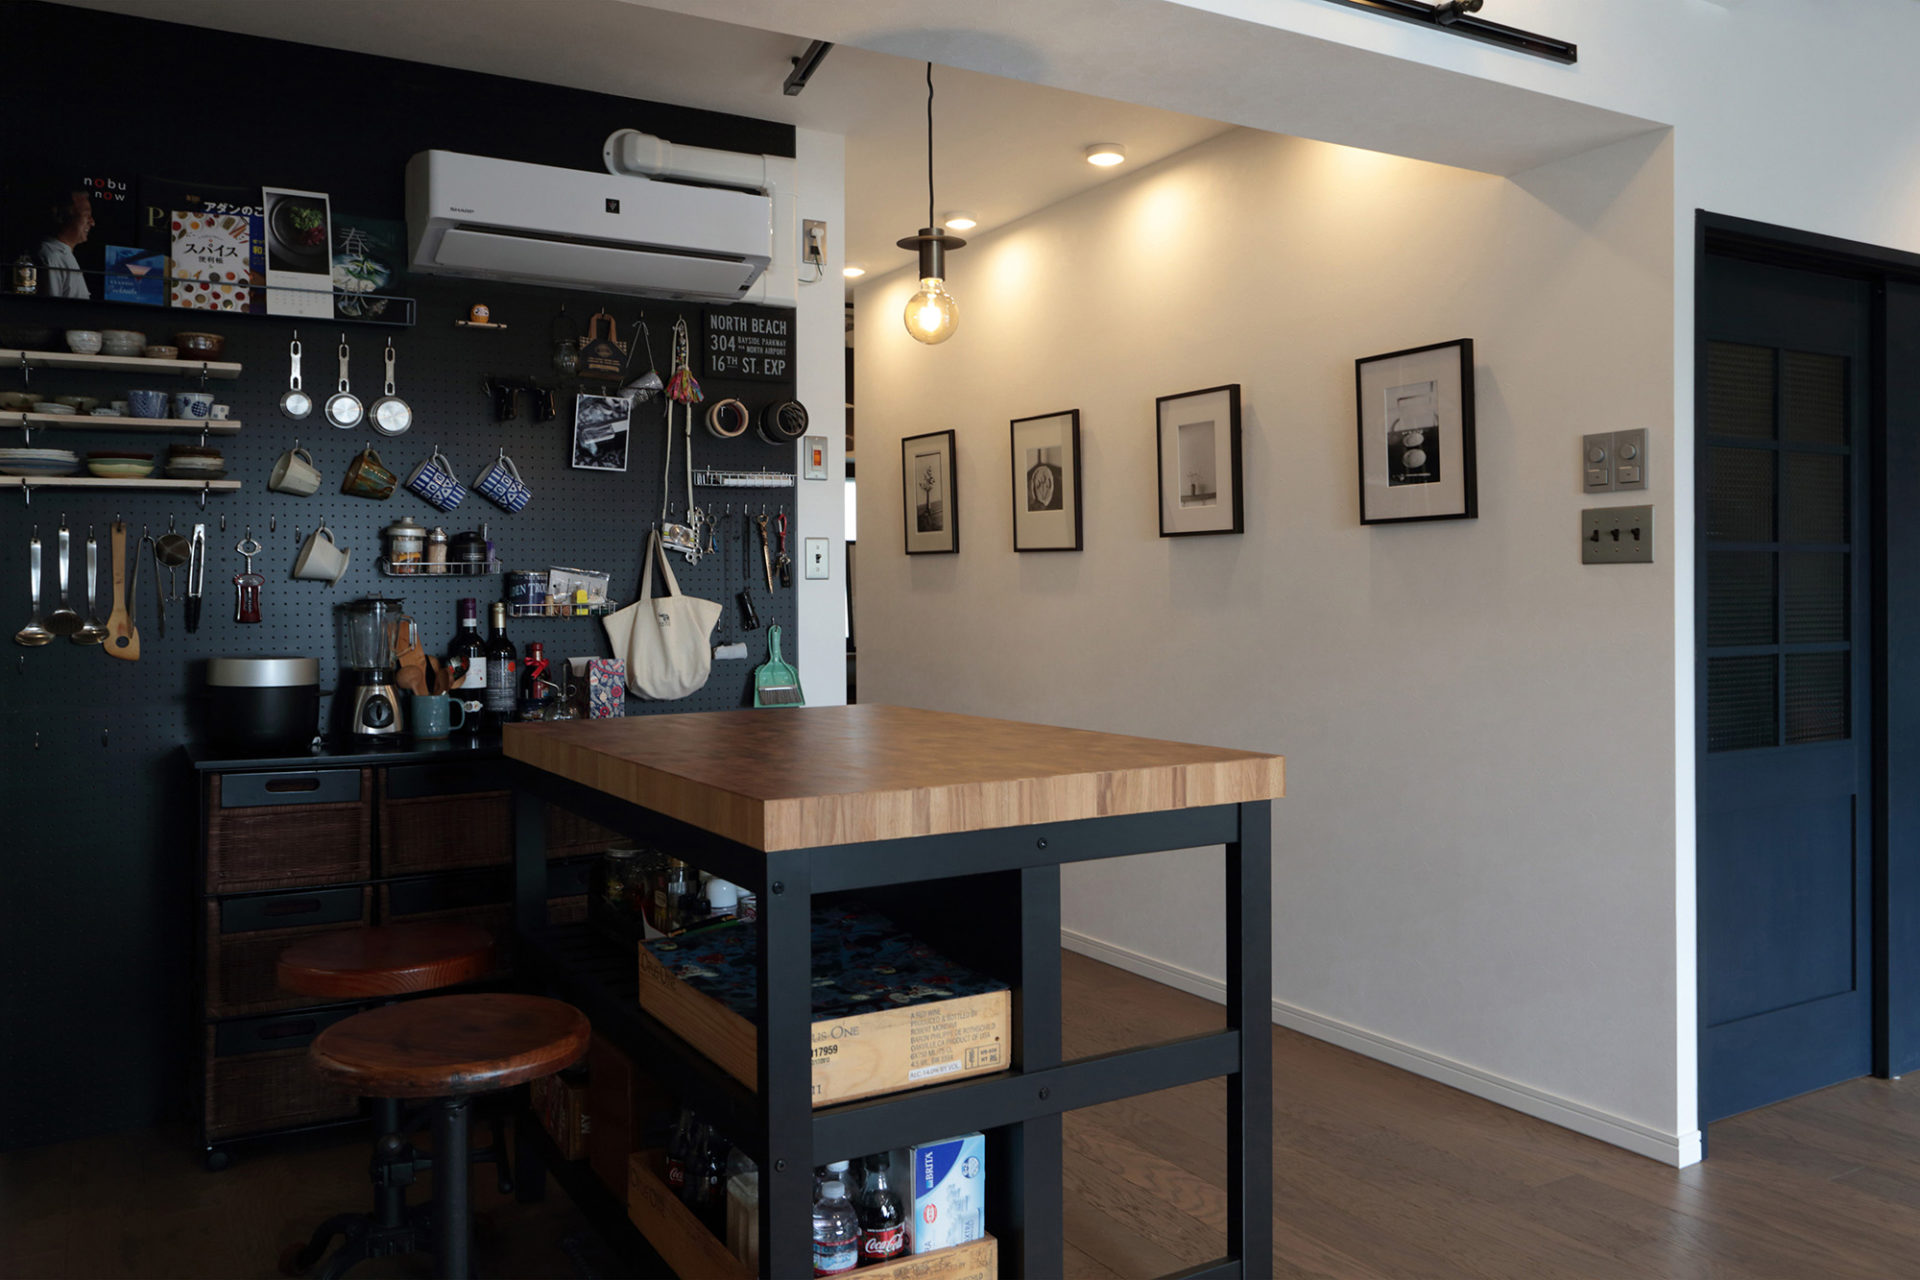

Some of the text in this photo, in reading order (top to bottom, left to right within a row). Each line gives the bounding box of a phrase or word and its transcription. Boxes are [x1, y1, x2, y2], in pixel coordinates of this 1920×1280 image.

[83, 176, 126, 191] nobu
[94, 190, 126, 202] now
[184, 243, 239, 257] スパイス
[710, 314, 787, 335] NORTH BEACH
[710, 334, 735, 352] 304
[761, 338, 786, 347] PARKWAY
[746, 346, 763, 354] NORTH
[764, 347, 786, 356] AIRPORT
[742, 357, 760, 374] ST.
[764, 359, 786, 376] EXP
[830, 1025, 860, 1041] ONE
[925, 1151, 934, 1181] BRITA
[864, 1232, 904, 1254] Coca-Cola
